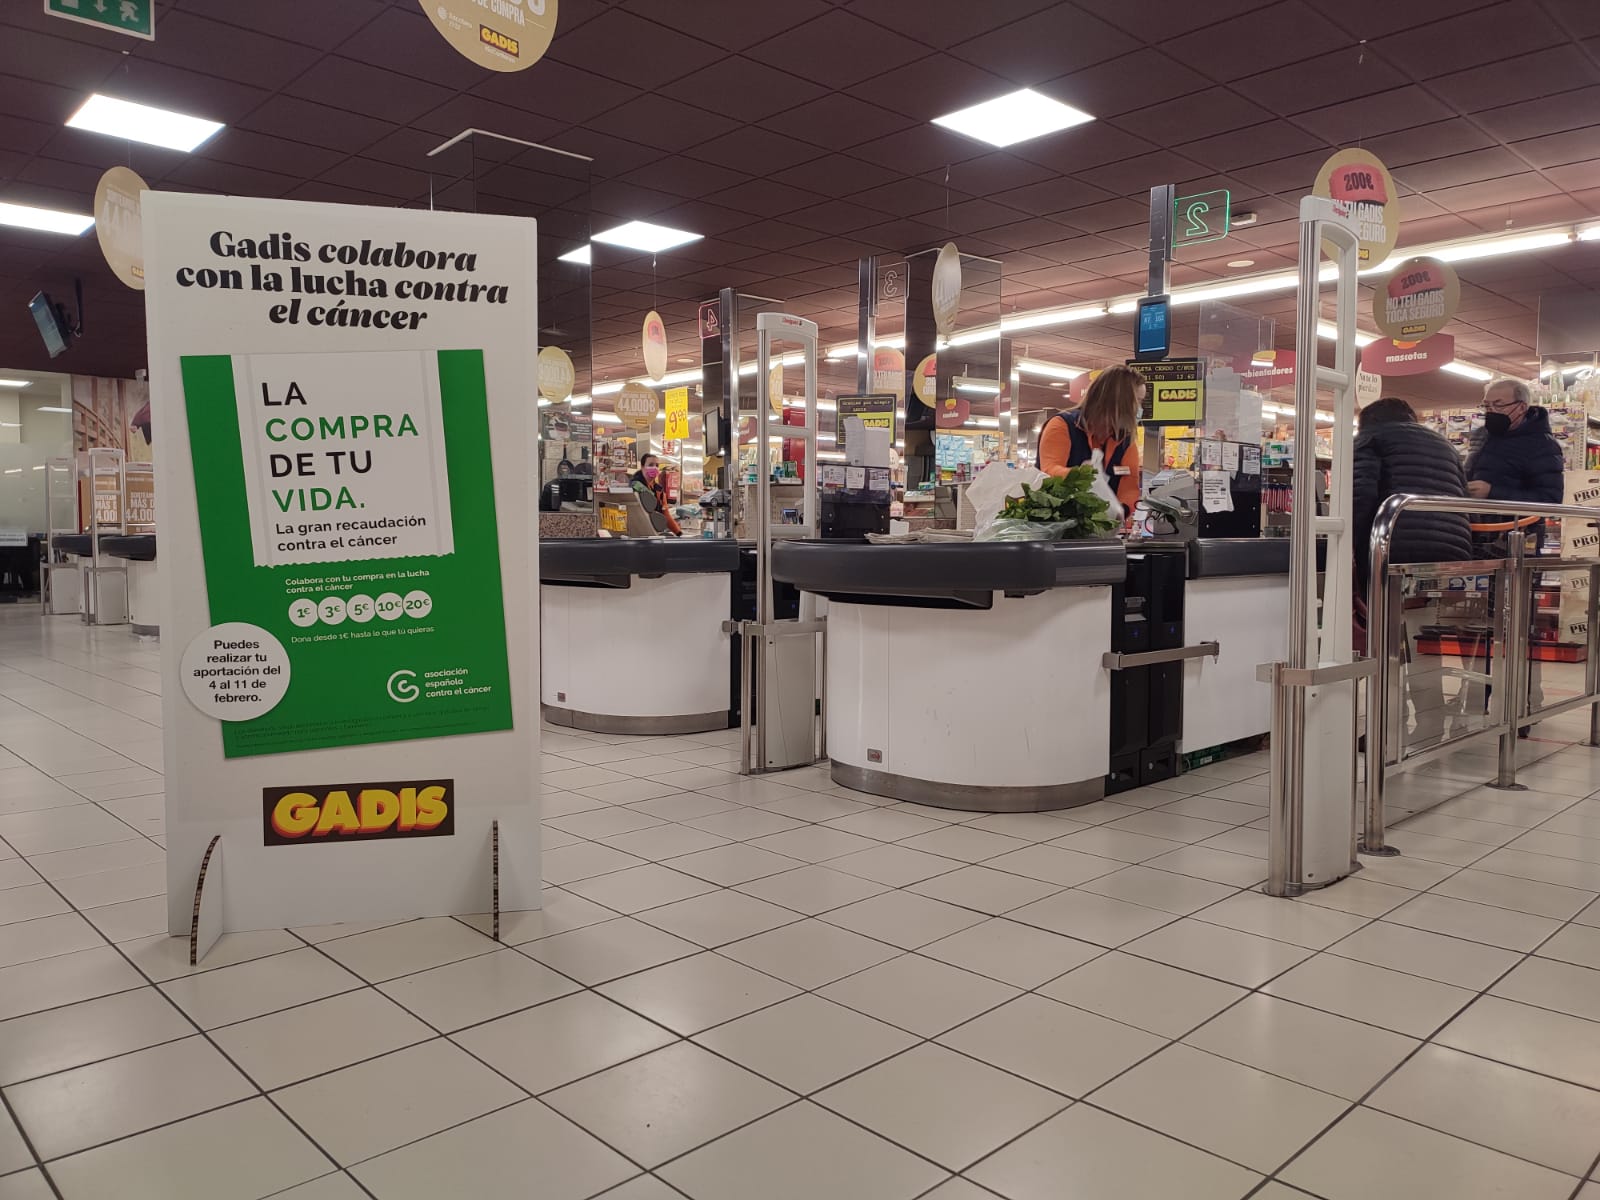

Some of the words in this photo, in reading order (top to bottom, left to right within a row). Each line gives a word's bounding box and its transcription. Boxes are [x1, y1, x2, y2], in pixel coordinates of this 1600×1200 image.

[490, 1, 525, 26] COMPRA
[481, 27, 518, 54] GADIS
[1343, 171, 1375, 191] 200€
[1359, 221, 1387, 244] EGURO
[209, 231, 311, 262] Gadis
[318, 239, 478, 272] colabora
[176, 267, 243, 289] con
[251, 264, 284, 292] la
[291, 266, 388, 298] lucha
[394, 278, 509, 304] contra
[1400, 270, 1431, 290] 200€
[1418, 289, 1445, 306] GADIS
[269, 299, 302, 324] el
[306, 300, 427, 330] cáncer
[1385, 351, 1428, 363] mascotas
[1240, 366, 1293, 378] mbientadores
[262, 382, 307, 406] LA
[1161, 389, 1197, 401] GADIS
[265, 413, 418, 442] COMPRA
[270, 453, 316, 478] DE
[326, 450, 372, 475] TU
[272, 486, 365, 513] VIDA.
[1573, 487, 1600, 502] PRO
[276, 523, 294, 535] La
[298, 523, 332, 536] gran
[336, 515, 426, 532] recaudación
[277, 537, 326, 551] contra
[330, 537, 344, 548] el
[348, 534, 398, 548] cáncer
[285, 577, 323, 586] Colabora
[325, 576, 341, 584] con
[352, 573, 384, 582] compra
[406, 569, 430, 577] lucha
[1571, 577, 1589, 589] PR
[286, 586, 313, 594] contra
[325, 583, 353, 591] cáncer
[354, 603, 369, 616] 5€
[378, 600, 401, 612] 10€
[405, 598, 431, 610] 20€
[297, 607, 311, 618] 1€
[325, 605, 341, 618] 3€
[1570, 624, 1587, 634] PR
[291, 635, 312, 644] Dona
[313, 633, 337, 642] desde
[350, 631, 371, 639] hasta
[372, 629, 380, 637] lo
[382, 629, 396, 638] que
[214, 640, 260, 649] Puedes
[207, 653, 252, 663] realizar
[255, 653, 267, 662] tu
[193, 666, 259, 679] aportación
[263, 665, 281, 675] del
[424, 667, 468, 678] asociación
[209, 680, 216, 690] 4
[220, 679, 230, 690] al
[234, 679, 247, 689] 11
[251, 679, 267, 689] de
[425, 678, 463, 688] española
[214, 693, 262, 703] febrero.
[426, 689, 452, 698] contra
[454, 687, 462, 695] el
[464, 685, 492, 694] cáncer
[271, 785, 448, 838] GADIS
